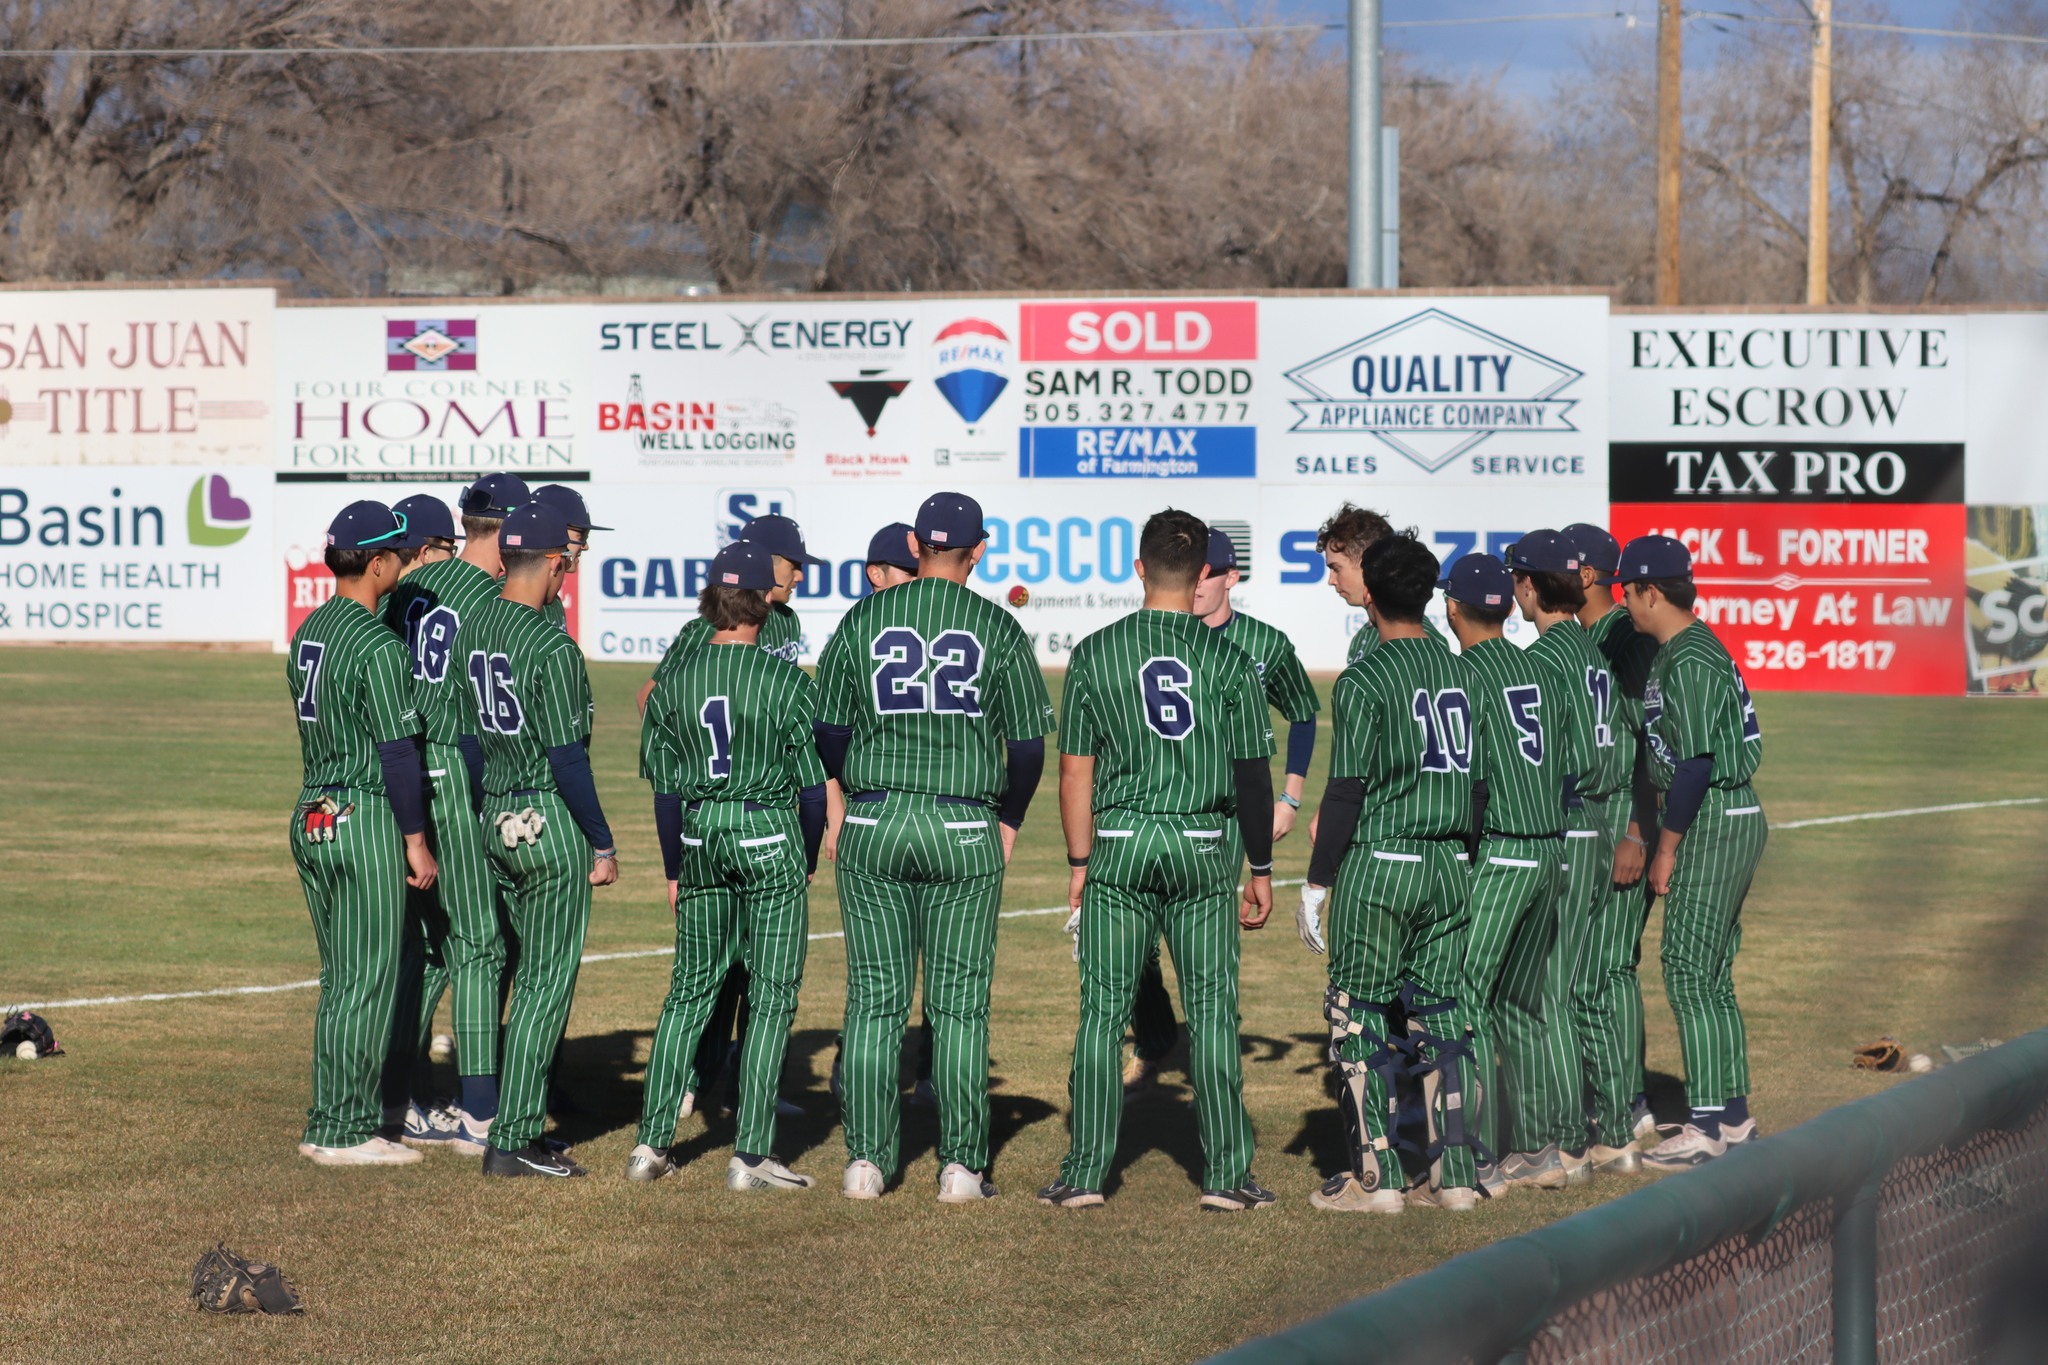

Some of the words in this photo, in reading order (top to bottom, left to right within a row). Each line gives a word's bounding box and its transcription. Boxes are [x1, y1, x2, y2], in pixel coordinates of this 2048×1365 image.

[0, 322, 89, 370] SAN
[107, 321, 251, 369] JUAN
[600, 322, 723, 351] STEEL
[770, 320, 914, 350] ENERGY
[1065, 311, 1213, 354] SOLD
[1629, 328, 1949, 369] EXECUTIVE
[938, 344, 1006, 366] RE/MAX
[294, 380, 385, 398] FOUR
[404, 379, 573, 397] CORNERS
[1025, 367, 1100, 397] SAM
[1111, 368, 1144, 396] R.
[1153, 367, 1254, 396] TODD
[1352, 354, 1513, 398] QUALITY
[38, 386, 199, 435] TITLE
[293, 397, 575, 441] HOME
[597, 401, 716, 432] BASIN
[1024, 402, 1249, 422] 505.327.4777
[1320, 404, 1434, 427] APPLIANCE
[1442, 404, 1547, 427] COMPANY
[1669, 385, 1908, 428] ESCROW
[293, 443, 364, 467] FOR
[378, 442, 573, 467] CHILDREN
[639, 432, 694, 451] WELL
[701, 432, 797, 451] LOGGING
[1076, 427, 1198, 457] RE/MAX
[825, 453, 864, 466] Black
[1076, 456, 1097, 474] of
[1101, 456, 1199, 477] Farmington
[1295, 456, 1378, 475] SALES
[1471, 456, 1586, 475] SERVICE
[1666, 450, 1779, 495] TAX
[1790, 450, 1907, 496] PRO
[0, 487, 164, 547] Basin
[1648, 528, 1724, 565] CK
[1737, 528, 1764, 566] L.
[1778, 528, 1930, 566] FORTNER
[0, 563, 87, 588] HOME
[101, 563, 221, 588] HEALTH
[25, 603, 163, 628] HOSPICE
[1812, 593, 1857, 627] At
[1872, 592, 1952, 627] Law
[1048, 632, 1074, 656] 64
[1744, 639, 1896, 671] 326-1817
[298, 640, 326, 723] 7
[871, 626, 985, 718] 22
[468, 649, 526, 735] 16
[1138, 656, 1196, 741] 6
[700, 695, 733, 780] 1
[1412, 687, 1473, 773] 10
[1503, 683, 1545, 767] 5
